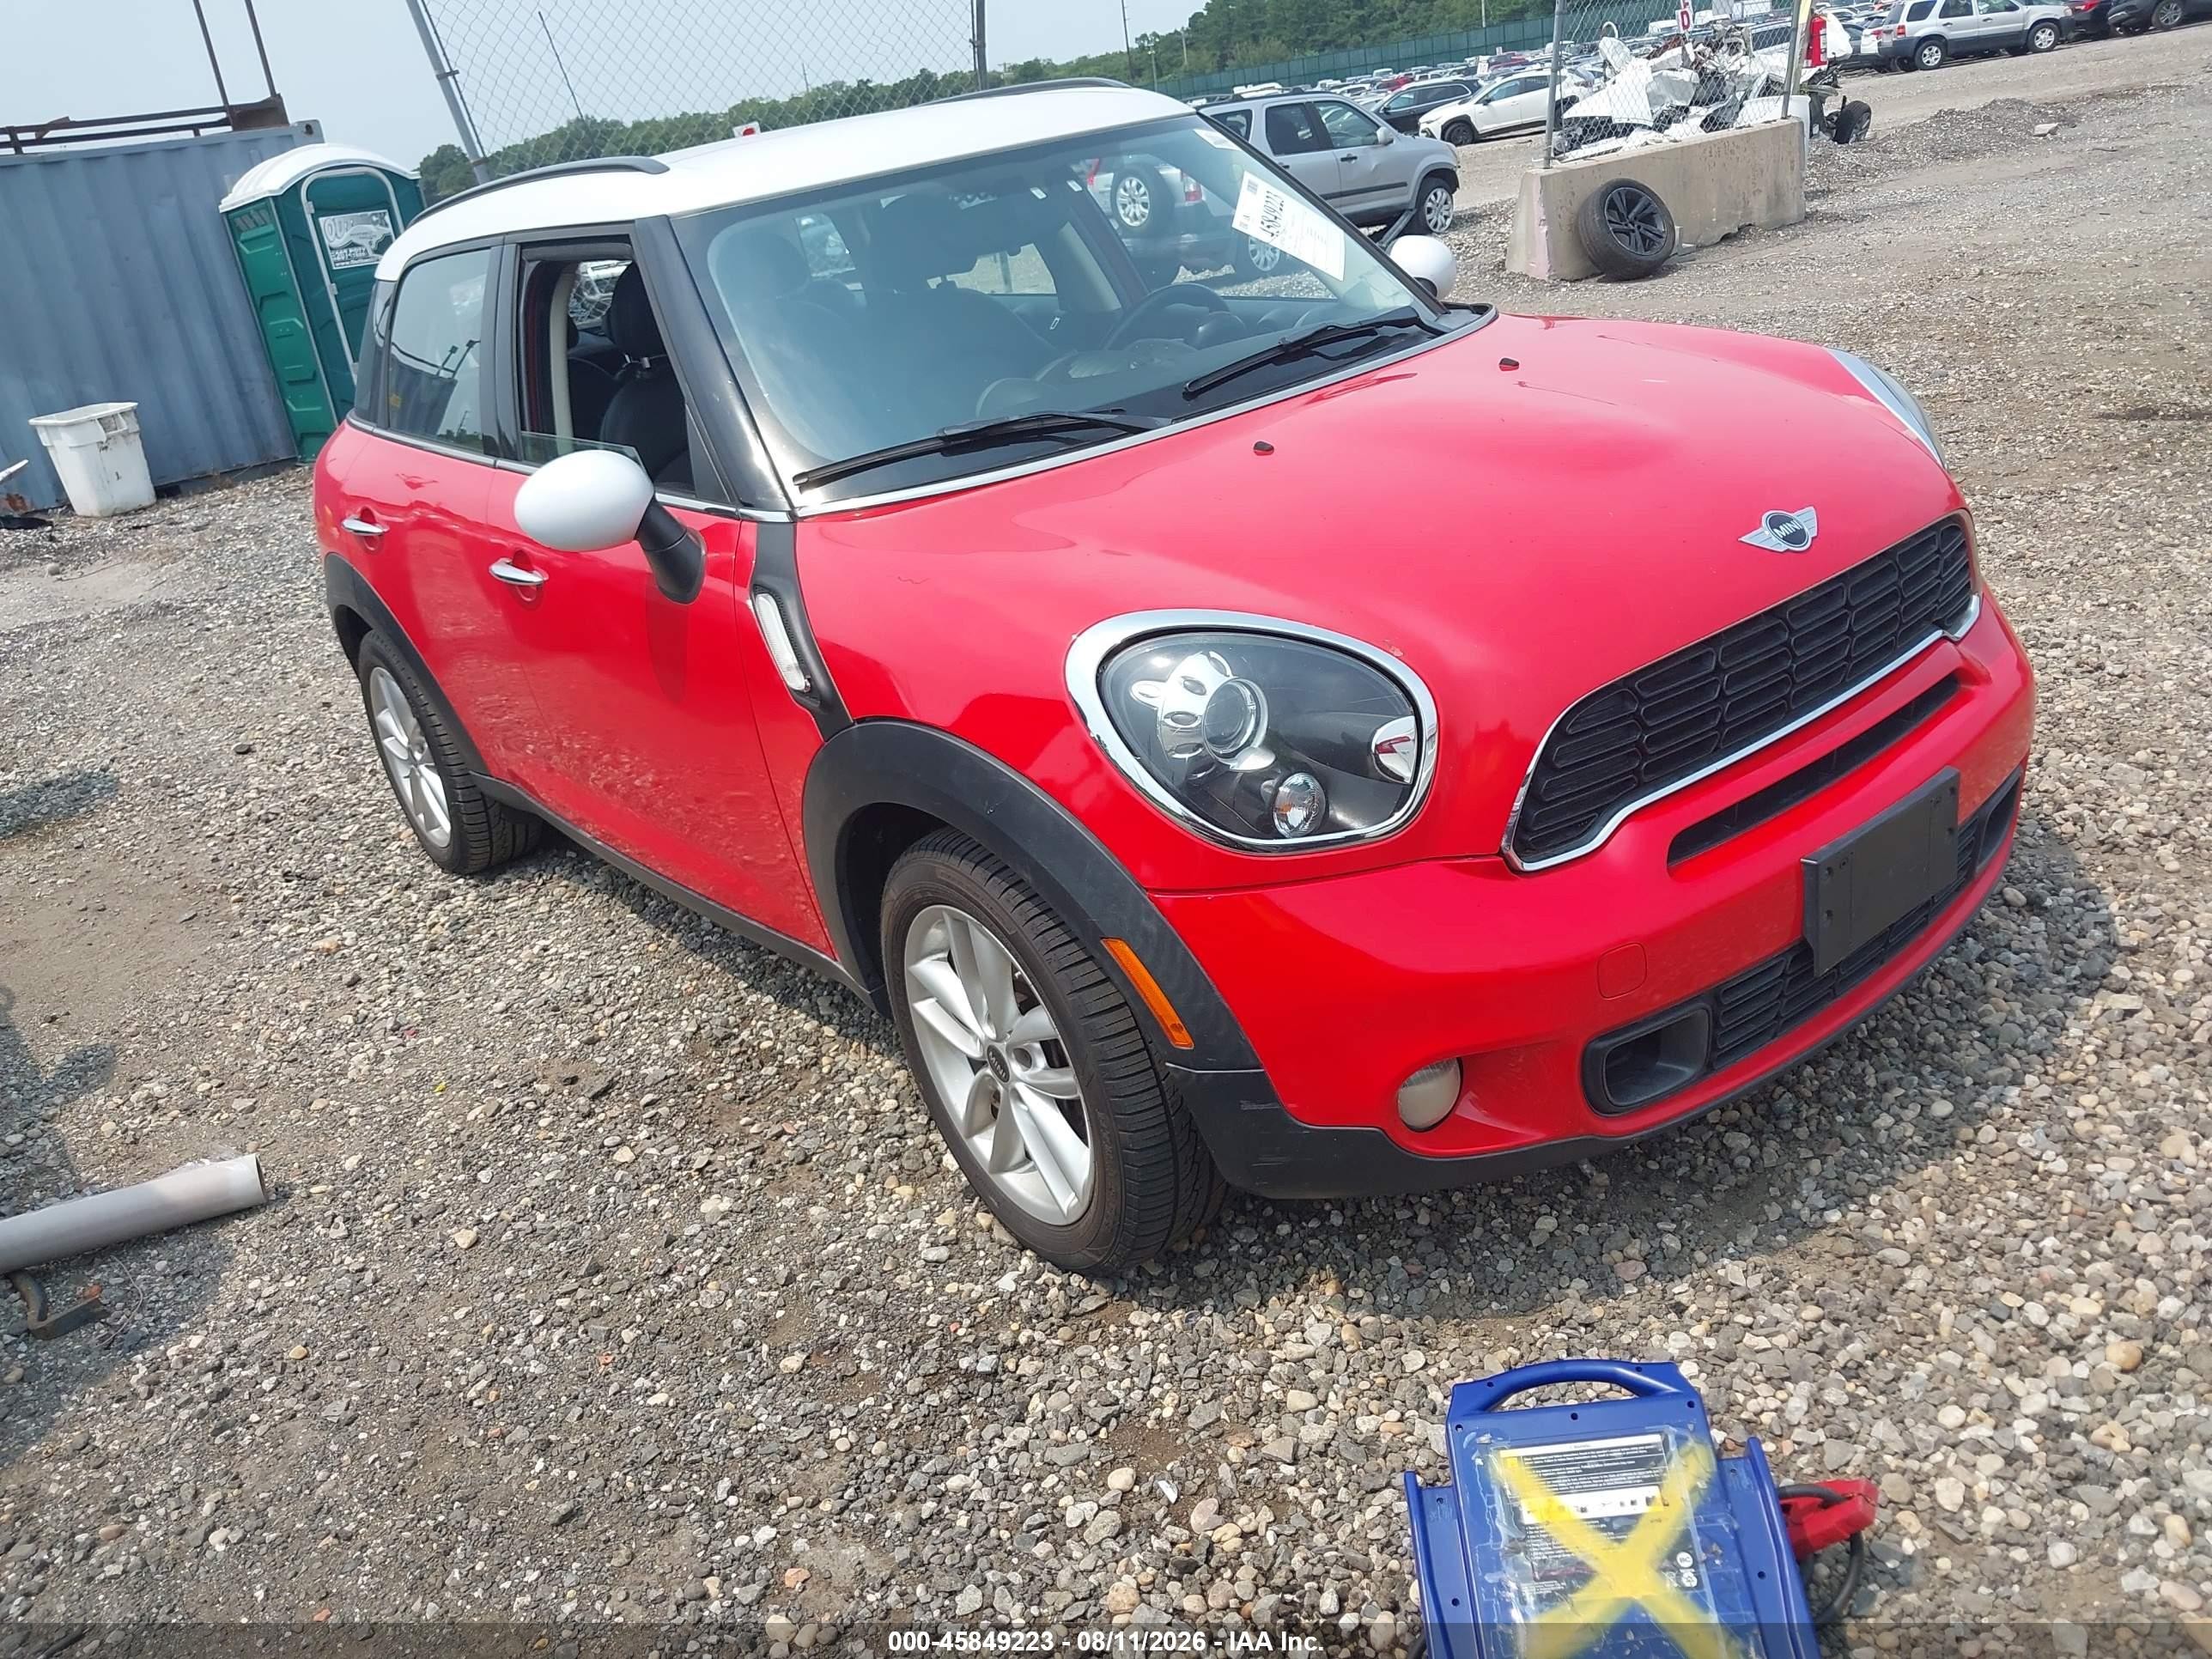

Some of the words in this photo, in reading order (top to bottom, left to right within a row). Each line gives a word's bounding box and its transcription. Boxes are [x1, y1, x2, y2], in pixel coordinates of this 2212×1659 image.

[324, 212, 390, 243] OUCK
[1772, 520, 1803, 538] MINI
[988, 1050, 1006, 1078] MINI
